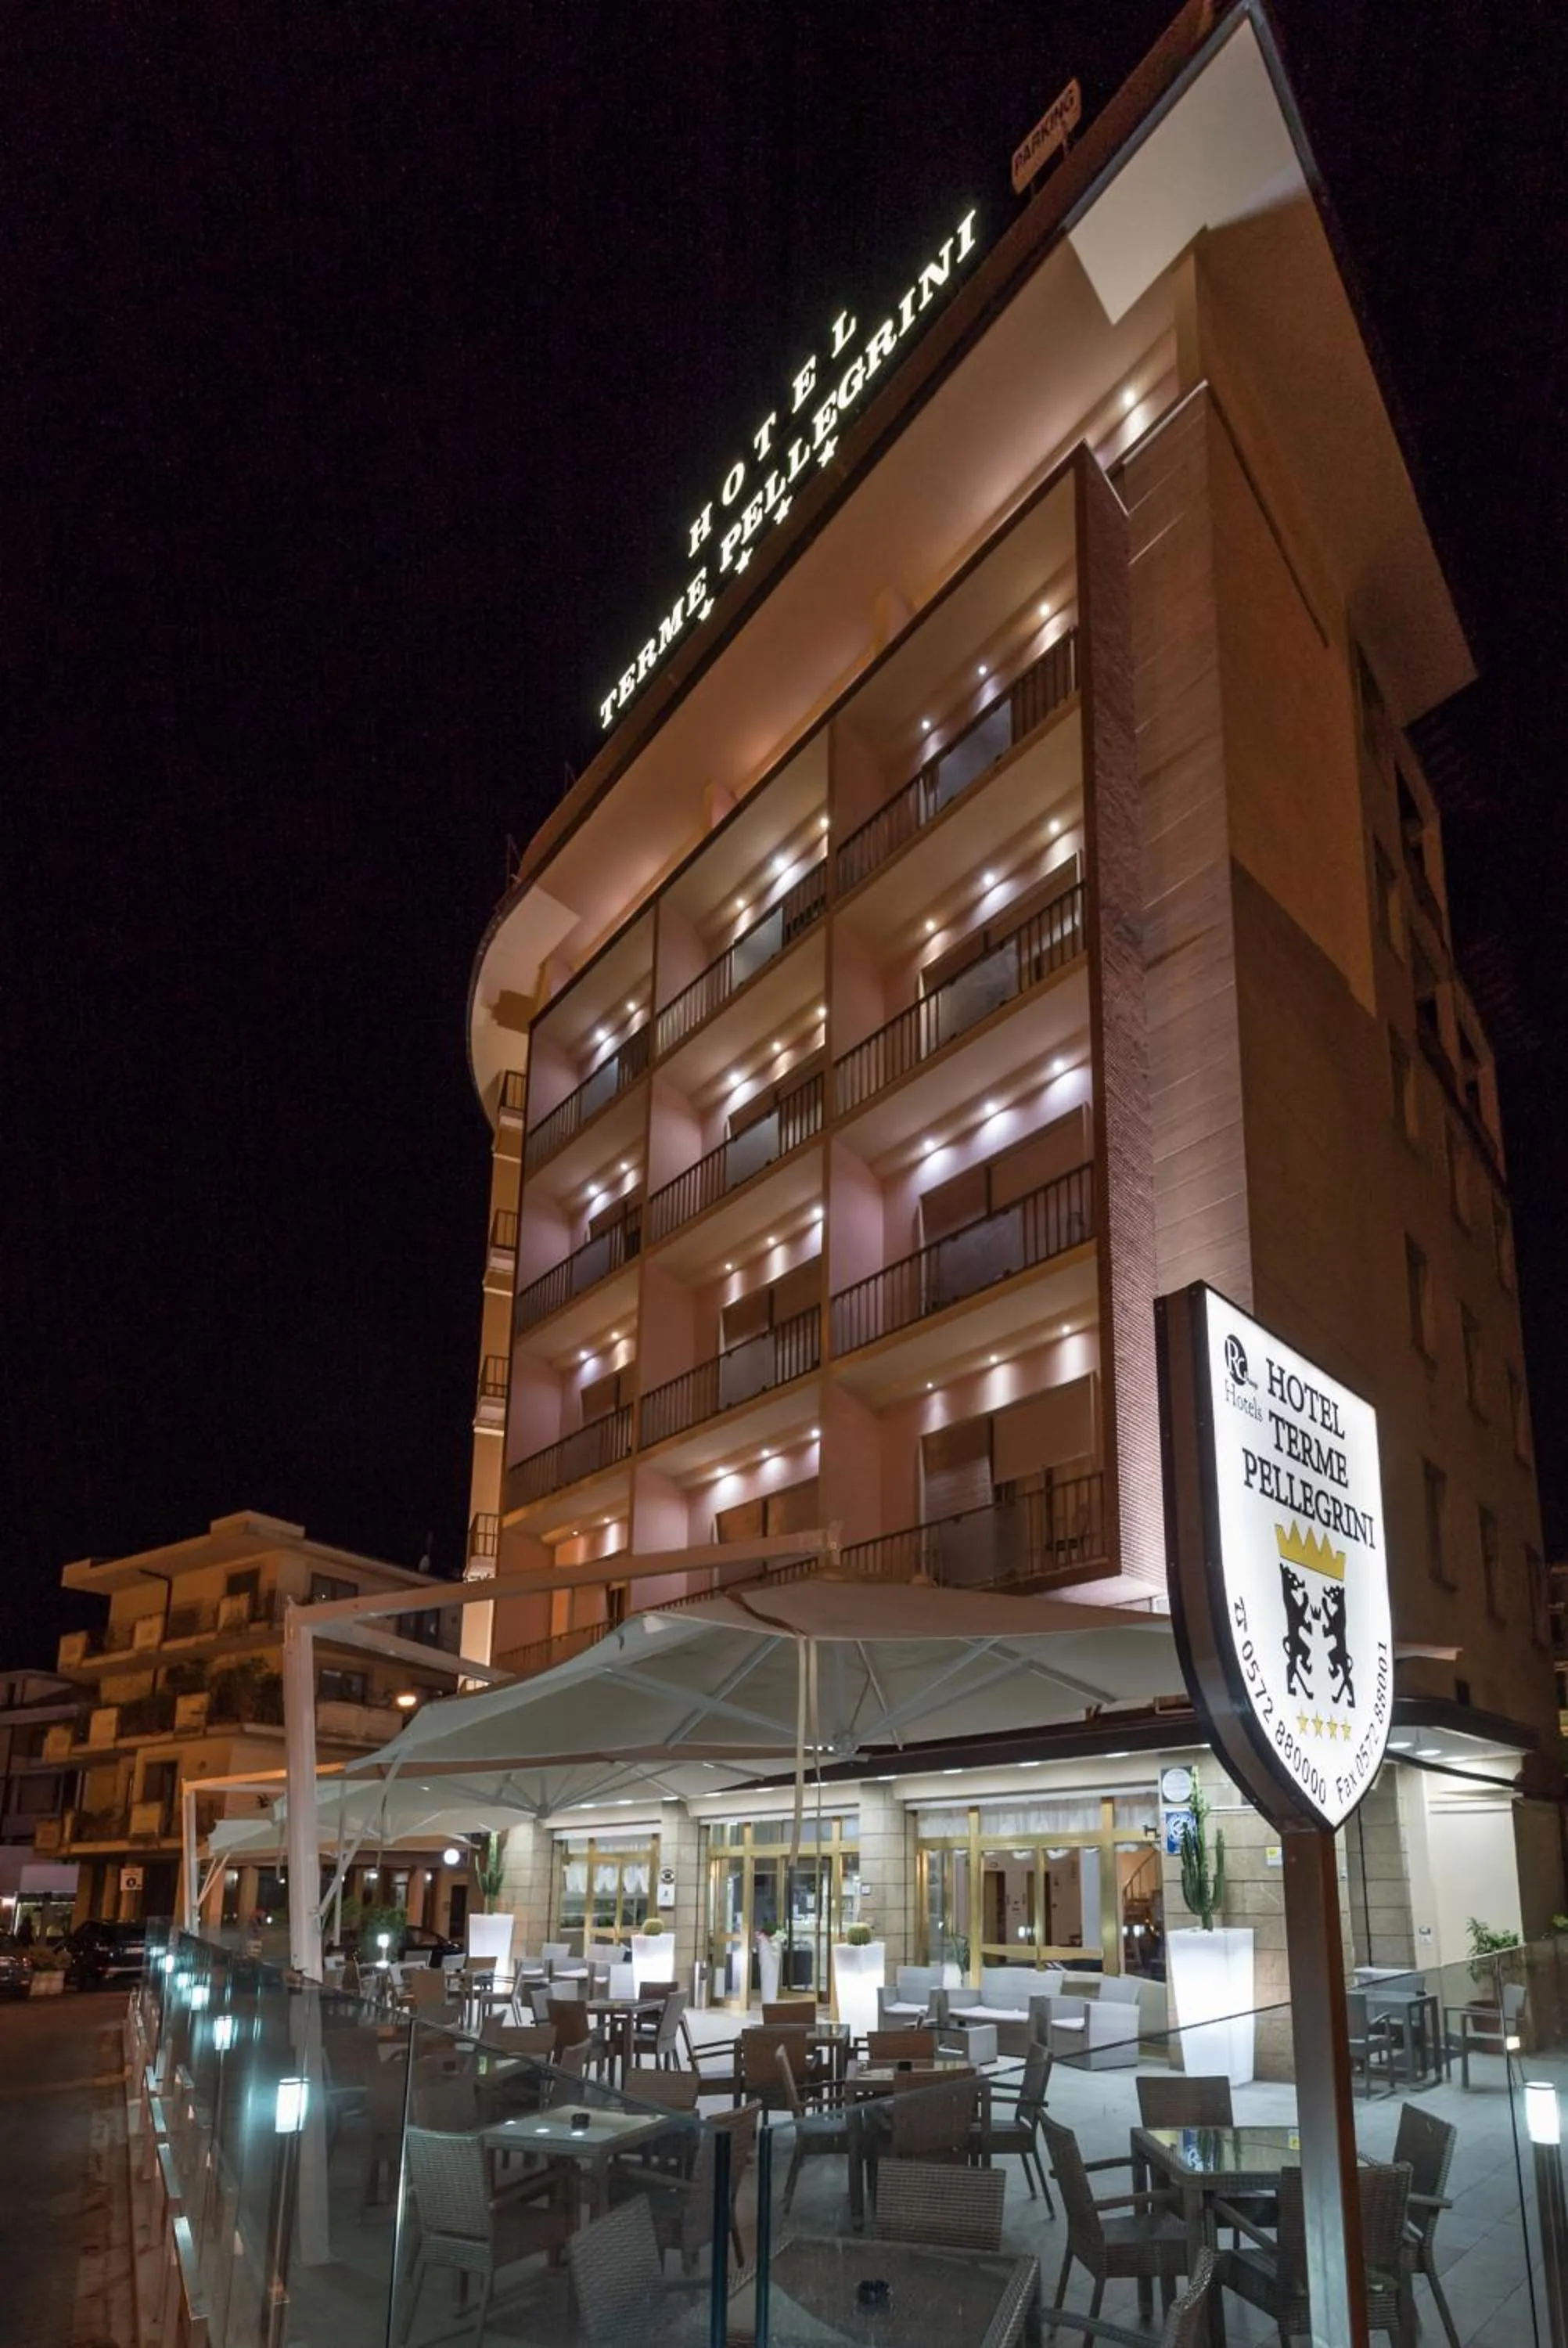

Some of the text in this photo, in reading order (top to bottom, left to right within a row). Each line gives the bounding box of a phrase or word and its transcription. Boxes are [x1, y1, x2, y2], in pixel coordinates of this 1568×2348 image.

[1014, 84, 1077, 178] PARKING
[599, 209, 976, 729] TERME PELLEGRINI
[688, 310, 856, 558] HOTEL
[1224, 1377, 1264, 1423] Hotels
[1265, 1358, 1345, 1440] HOTEL
[1268, 1410, 1349, 1489] TERME
[1242, 1447, 1376, 1550] PELLEGRINI
[1241, 1640, 1327, 1805] 0572 880000
[1335, 1774, 1358, 1804] Fax
